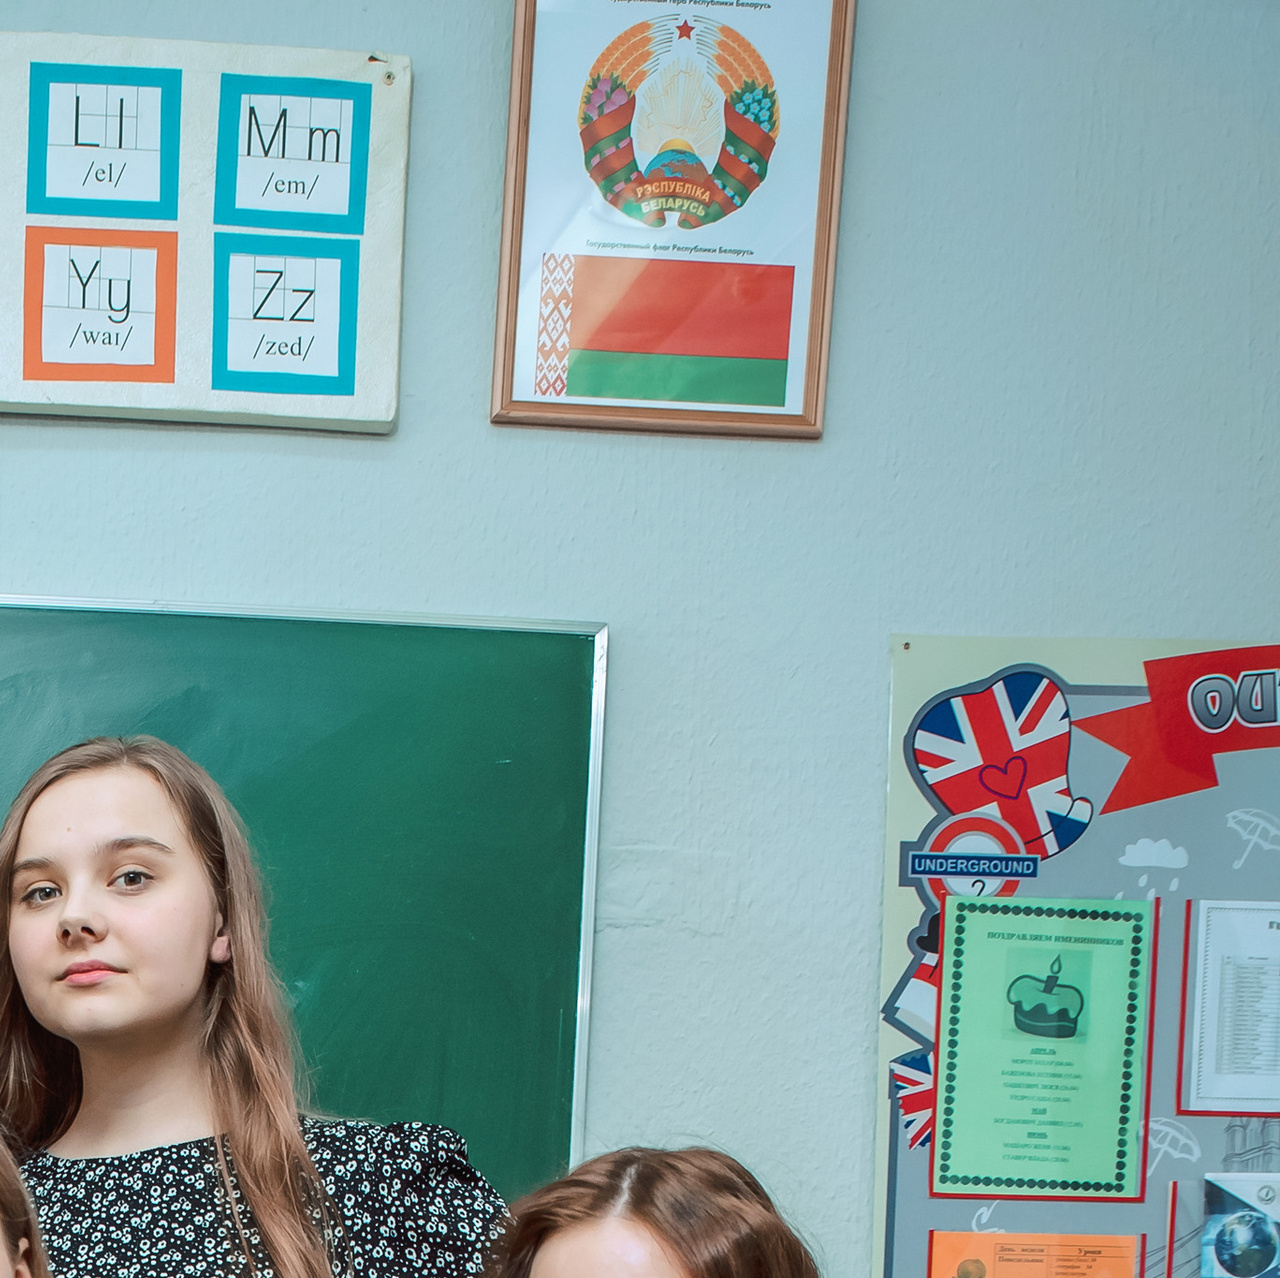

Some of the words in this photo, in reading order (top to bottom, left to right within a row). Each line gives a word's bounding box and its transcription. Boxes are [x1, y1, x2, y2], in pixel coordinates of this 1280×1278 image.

[736, 0, 772, 10] Беларусь
[83, 162, 126, 187] /el/
[262, 173, 318, 199] /em/
[636, 180, 711, 202] РЭСПУБЛІКА
[640, 197, 706, 216] БЕЛАРУСЬ
[586, 239, 651, 250] Государственный
[652, 243, 670, 252] флаг
[672, 243, 717, 255] Республики
[718, 246, 754, 256] Беларусь
[71, 260, 130, 323] Yy
[253, 271, 314, 321] Zz
[254, 335, 314, 361] /zed/
[1187, 669, 1280, 733] OU
[914, 857, 1034, 875] UNDERGROUND
[987, 931, 1052, 942] ПОЗДРАВЛЯЕМ
